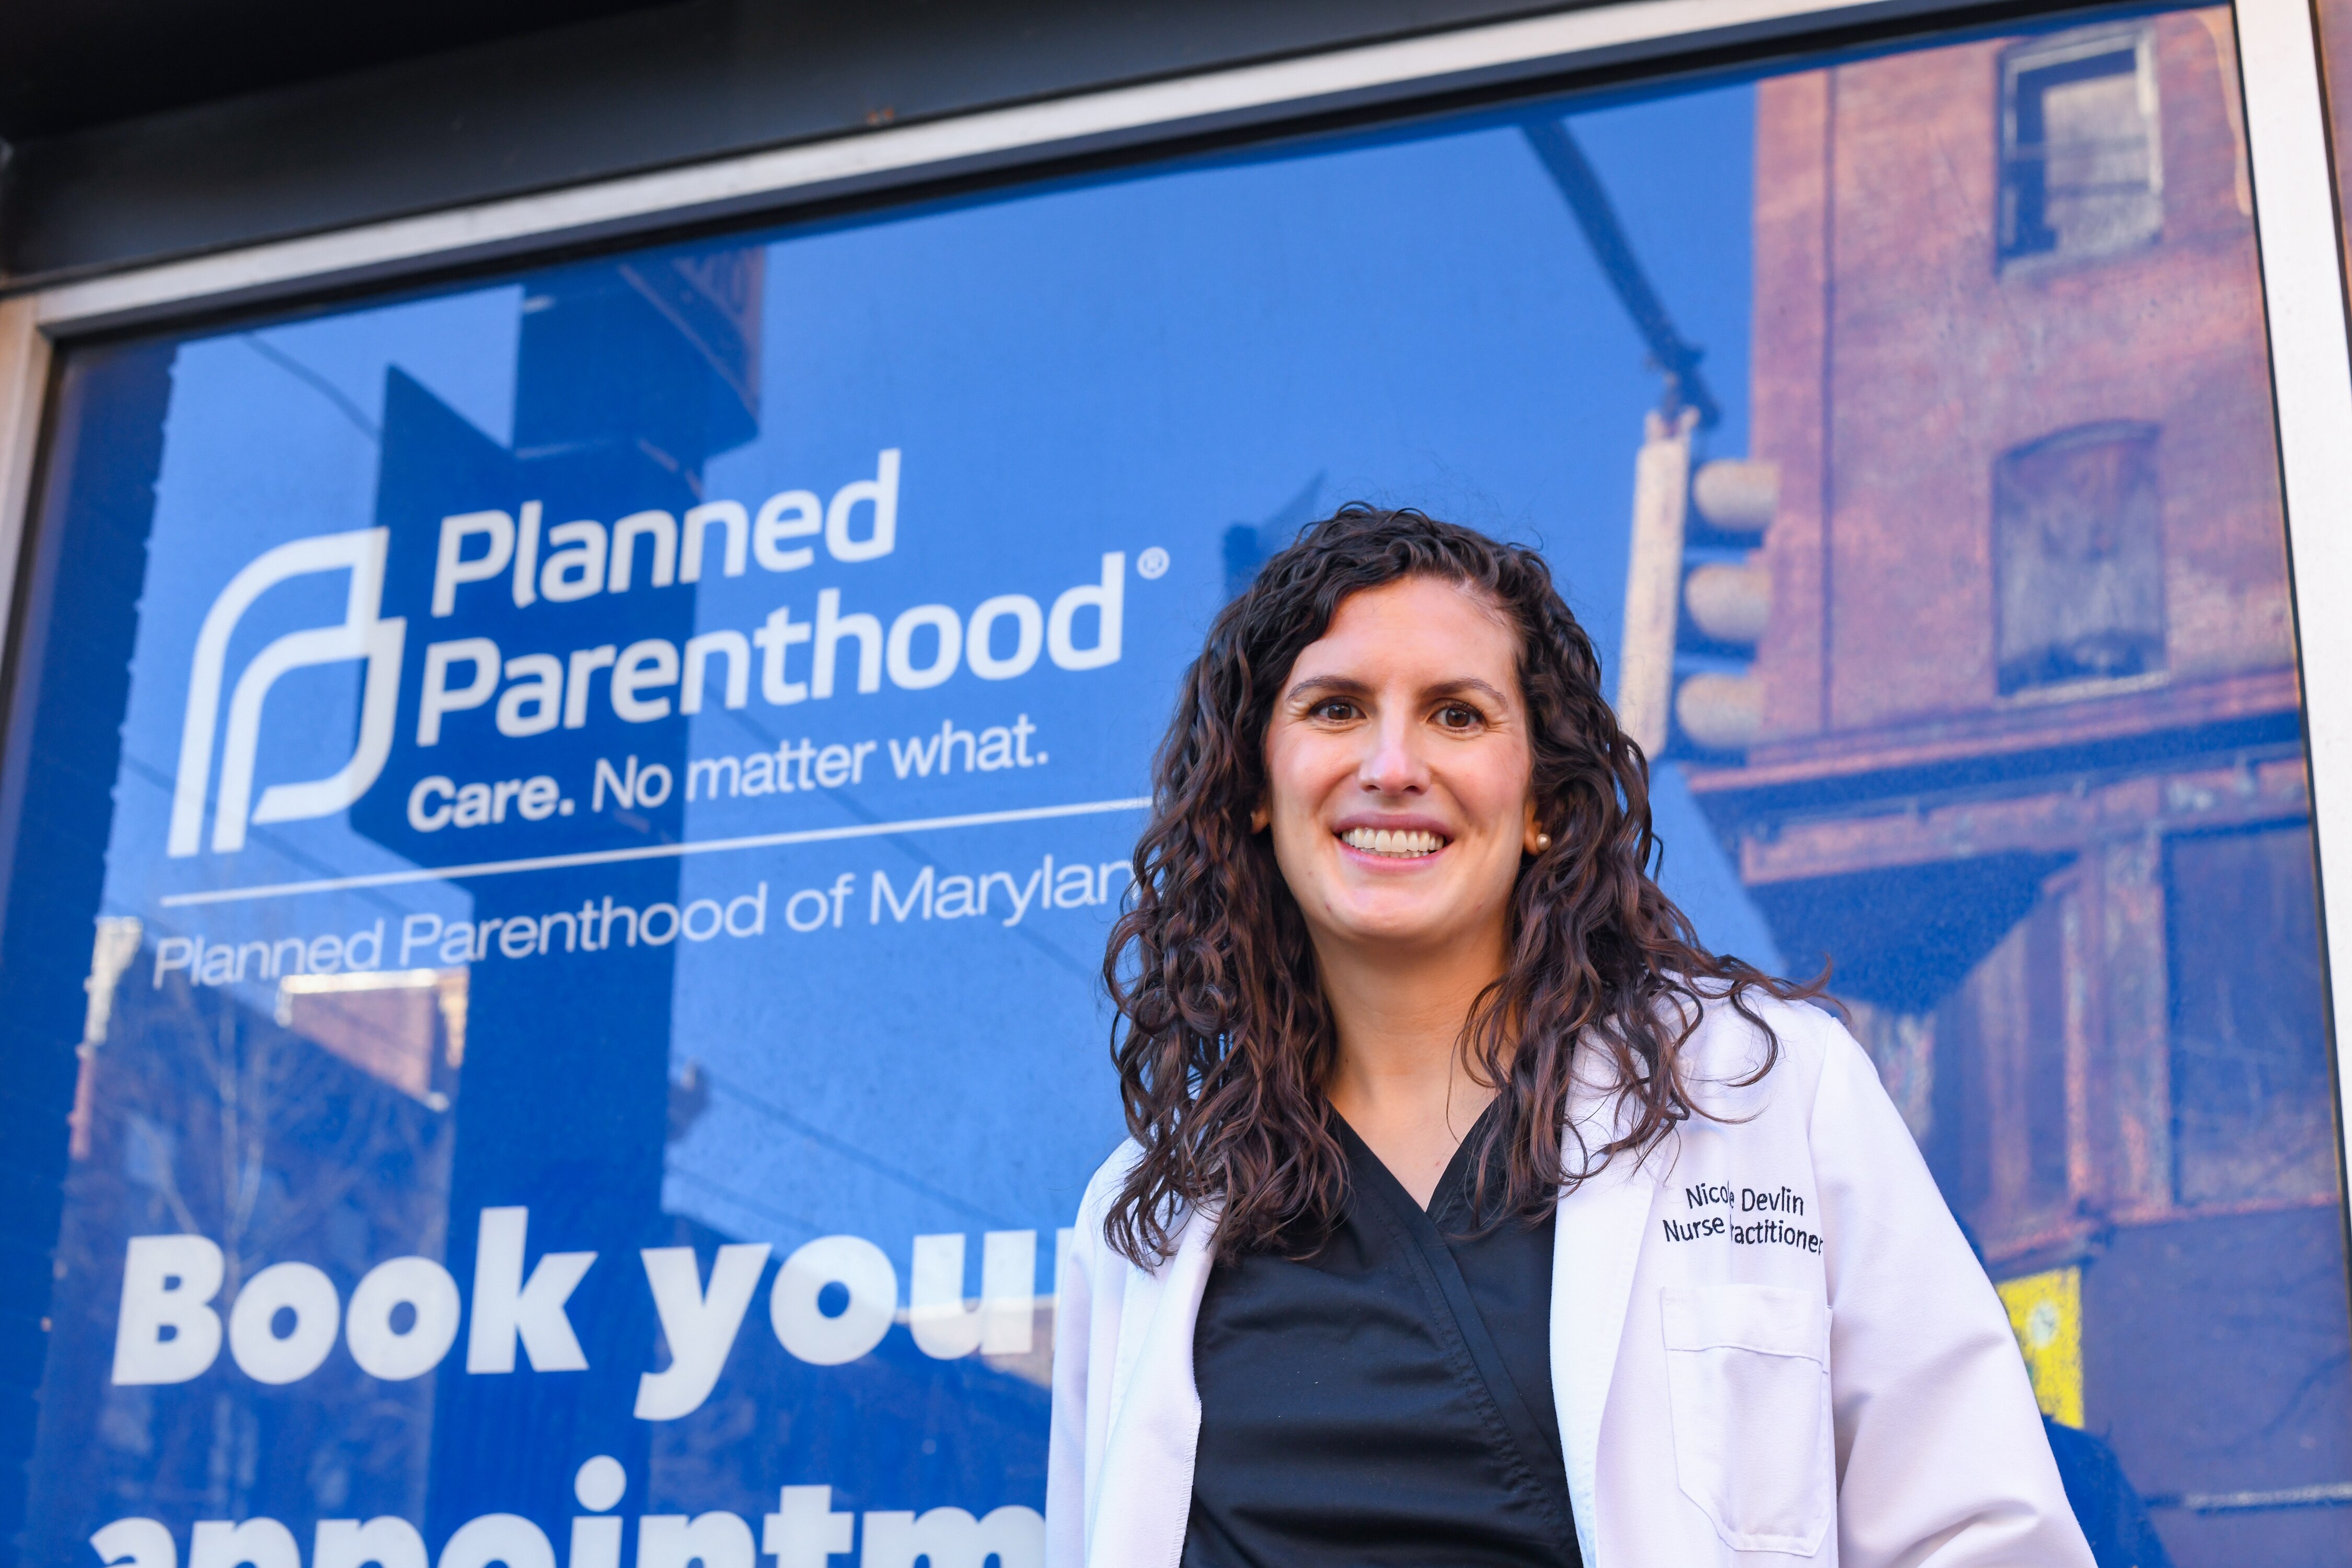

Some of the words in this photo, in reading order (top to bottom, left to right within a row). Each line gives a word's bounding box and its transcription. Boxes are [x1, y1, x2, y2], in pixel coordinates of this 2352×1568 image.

[431, 448, 901, 617] Planned
[417, 551, 1126, 746] Parenthood
[407, 776, 575, 832] Care.
[592, 755, 673, 812] No
[686, 739, 877, 802] matter
[889, 714, 1048, 779] what.
[153, 918, 386, 989] Planned
[399, 881, 768, 969] Parenthood
[785, 873, 855, 932] of
[869, 853, 1165, 928] Marylan
[1663, 1216, 1725, 1242] Nurse
[1729, 1214, 1824, 1256] ractitioner
[1685, 1180, 1734, 1209] Nicole
[1742, 1186, 1804, 1216] Devlin
[111, 1206, 599, 1386] Book
